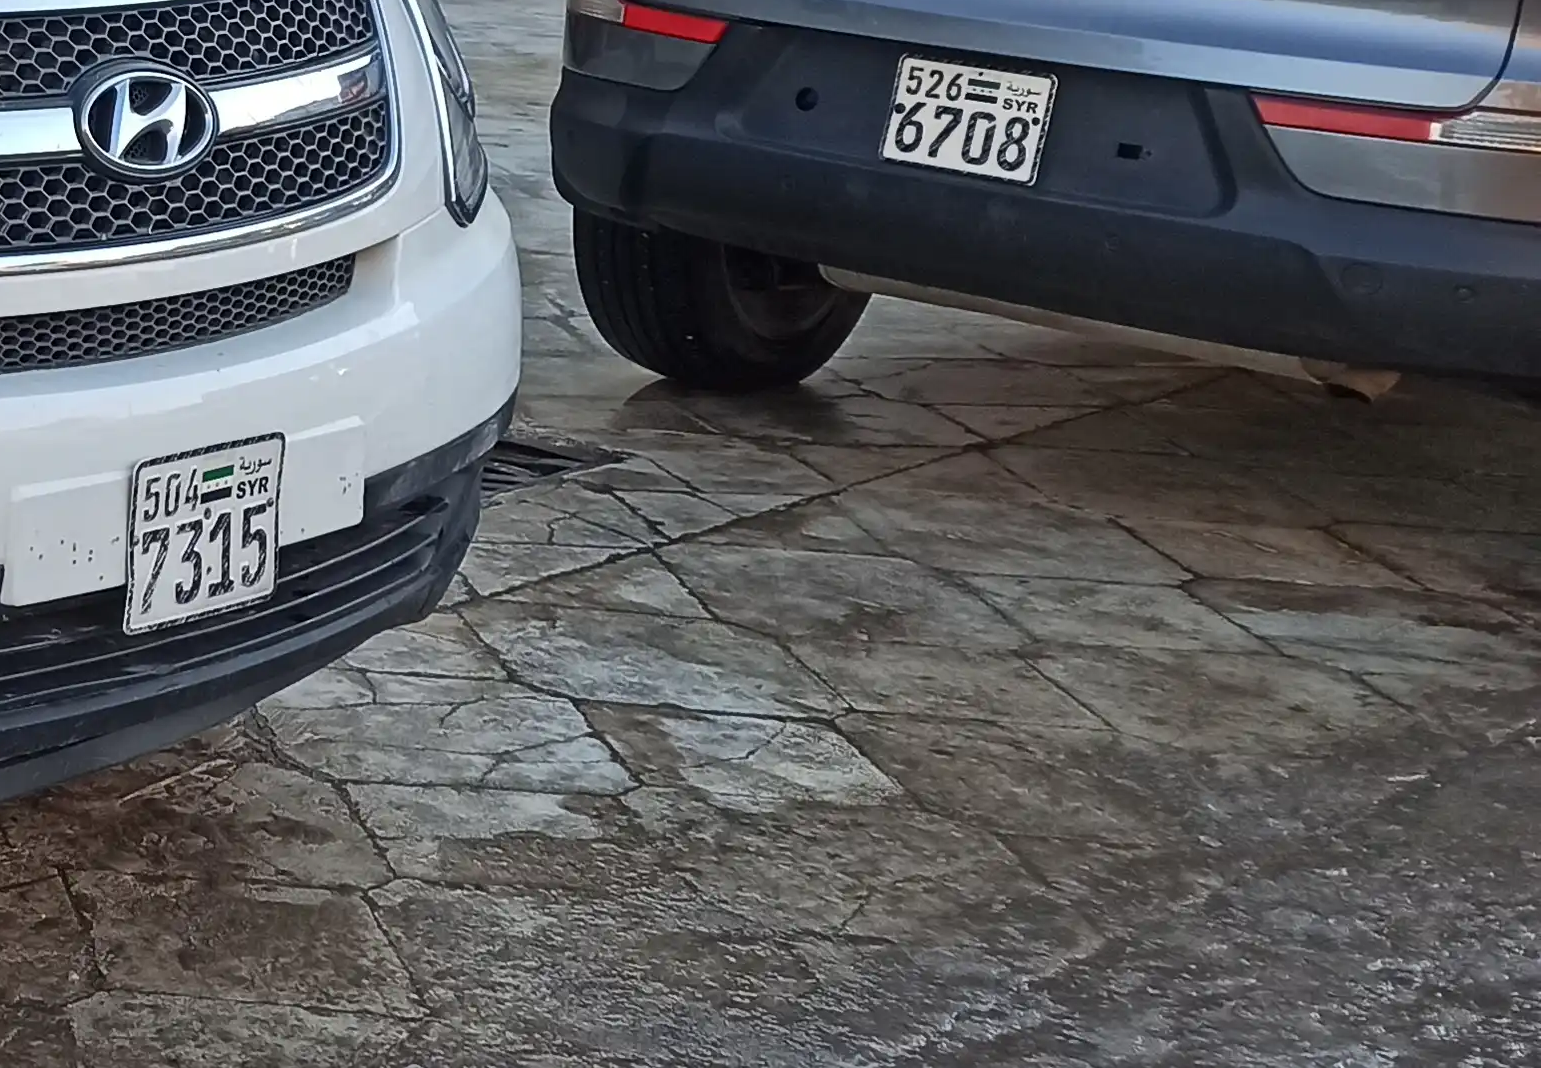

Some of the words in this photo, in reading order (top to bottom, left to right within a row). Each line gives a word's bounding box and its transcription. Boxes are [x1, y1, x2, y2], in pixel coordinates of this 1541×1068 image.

[906, 66, 964, 101] 526
[1006, 80, 1043, 96] سورية
[1002, 98, 1039, 114] SYR
[895, 102, 1031, 172] 6708
[239, 456, 273, 475] سورية
[143, 468, 199, 522] 504
[236, 476, 269, 499] SYR
[140, 503, 269, 614] 7315
